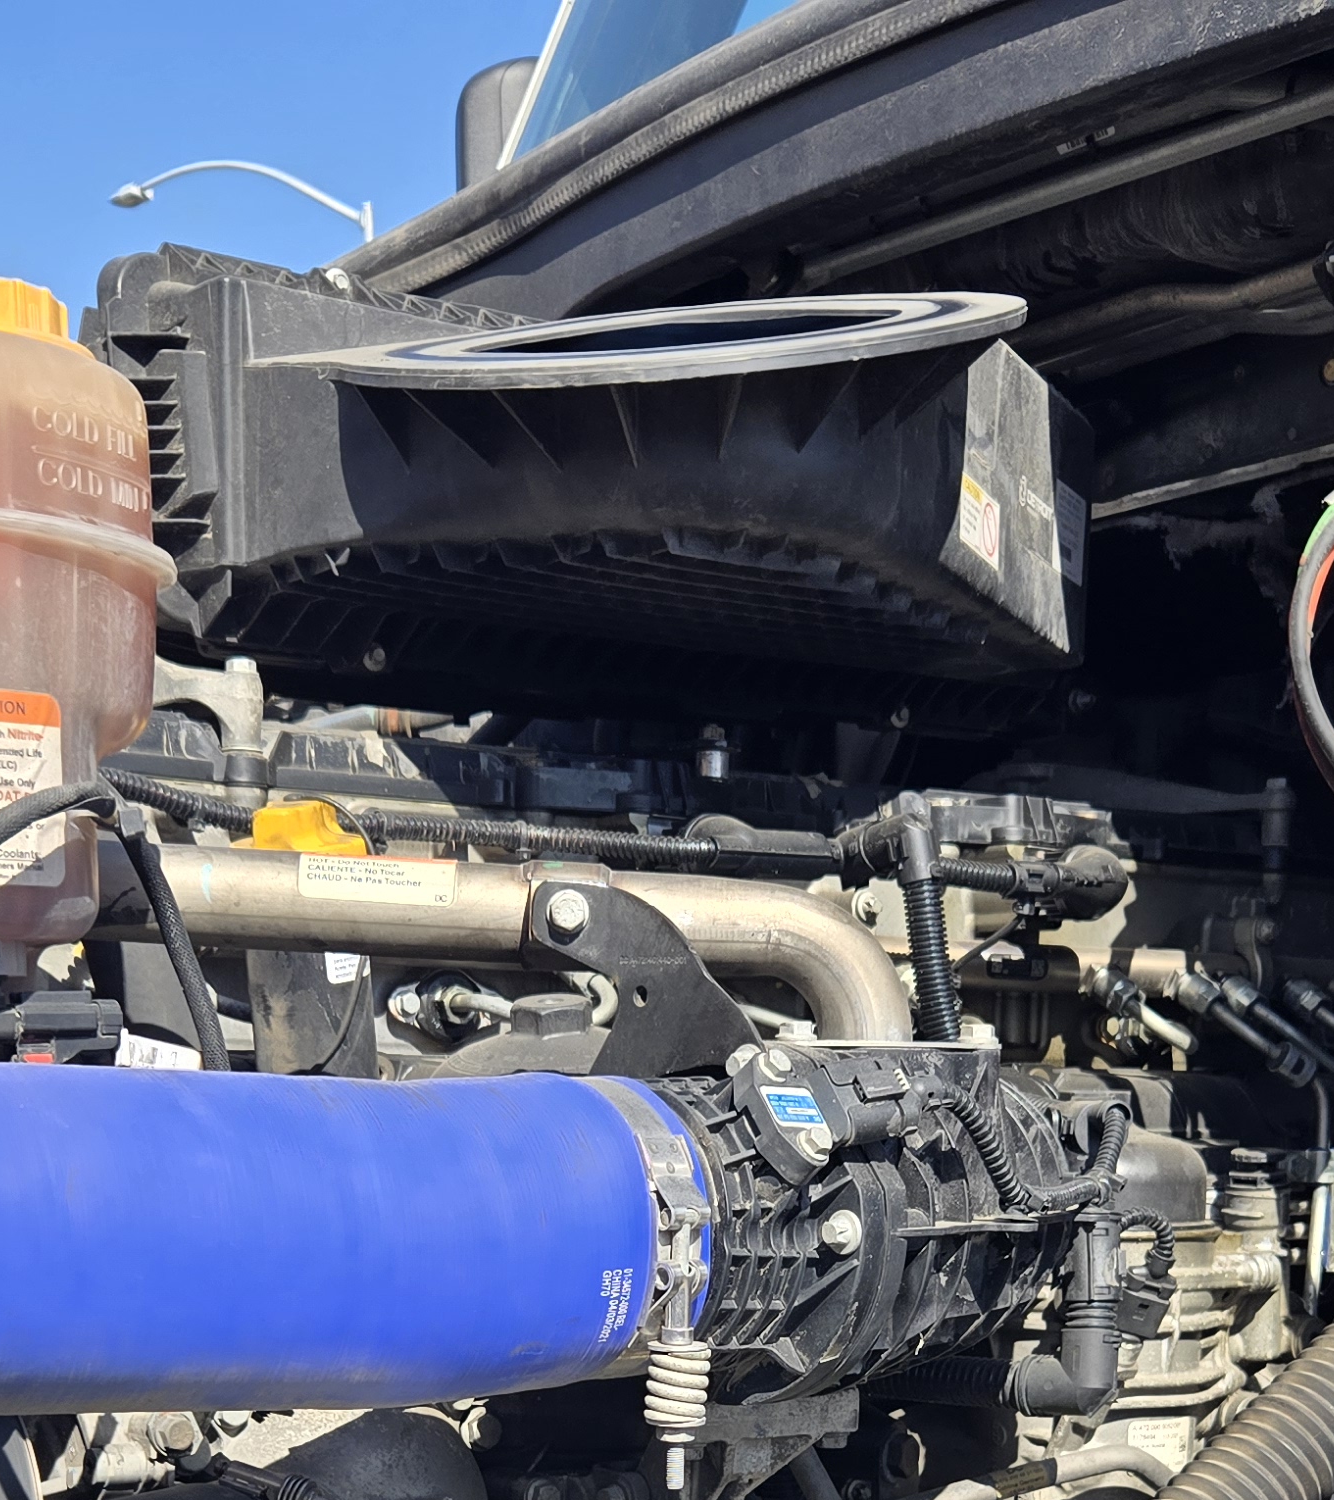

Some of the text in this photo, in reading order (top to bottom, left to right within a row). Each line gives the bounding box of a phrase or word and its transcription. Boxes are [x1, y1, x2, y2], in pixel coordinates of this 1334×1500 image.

[32, 406, 137, 462] COLD FILL
[38, 458, 103, 498] COLD
[27, 748, 42, 758] Life
[17, 778, 36, 790] Only
[307, 864, 356, 874] CALIENTE
[306, 873, 342, 882] CHAUD
[350, 875, 363, 883] Ne
[365, 877, 382, 885] Pas
[385, 877, 422, 887] Toucher
[600, 1270, 613, 1297] GH70
[598, 1269, 623, 1343] CHINA 04/03/2021
